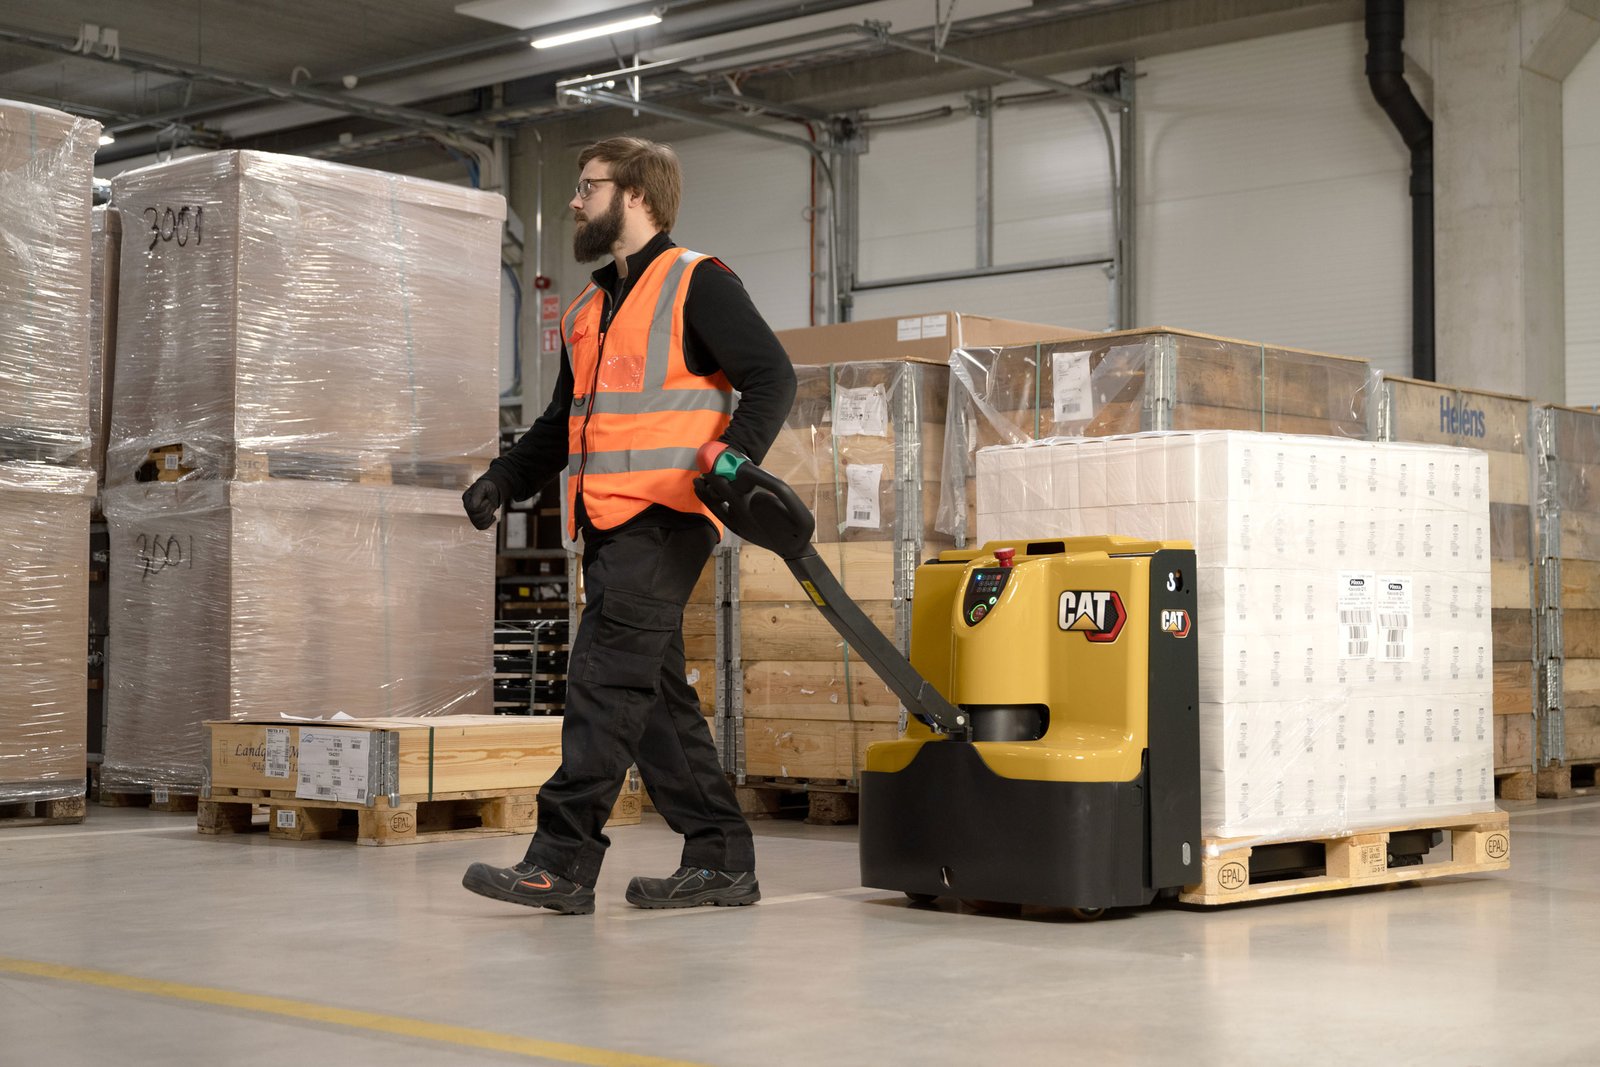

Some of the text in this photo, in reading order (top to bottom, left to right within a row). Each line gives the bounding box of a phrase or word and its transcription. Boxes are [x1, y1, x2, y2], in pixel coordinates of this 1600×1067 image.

[1440, 395, 1486, 438] Heléns
[1059, 591, 1111, 631] CAT
[1162, 610, 1184, 631] CAT
[393, 816, 411, 829] EPAL
[1488, 839, 1506, 854] EPAL
[1221, 868, 1243, 885] EPAL
